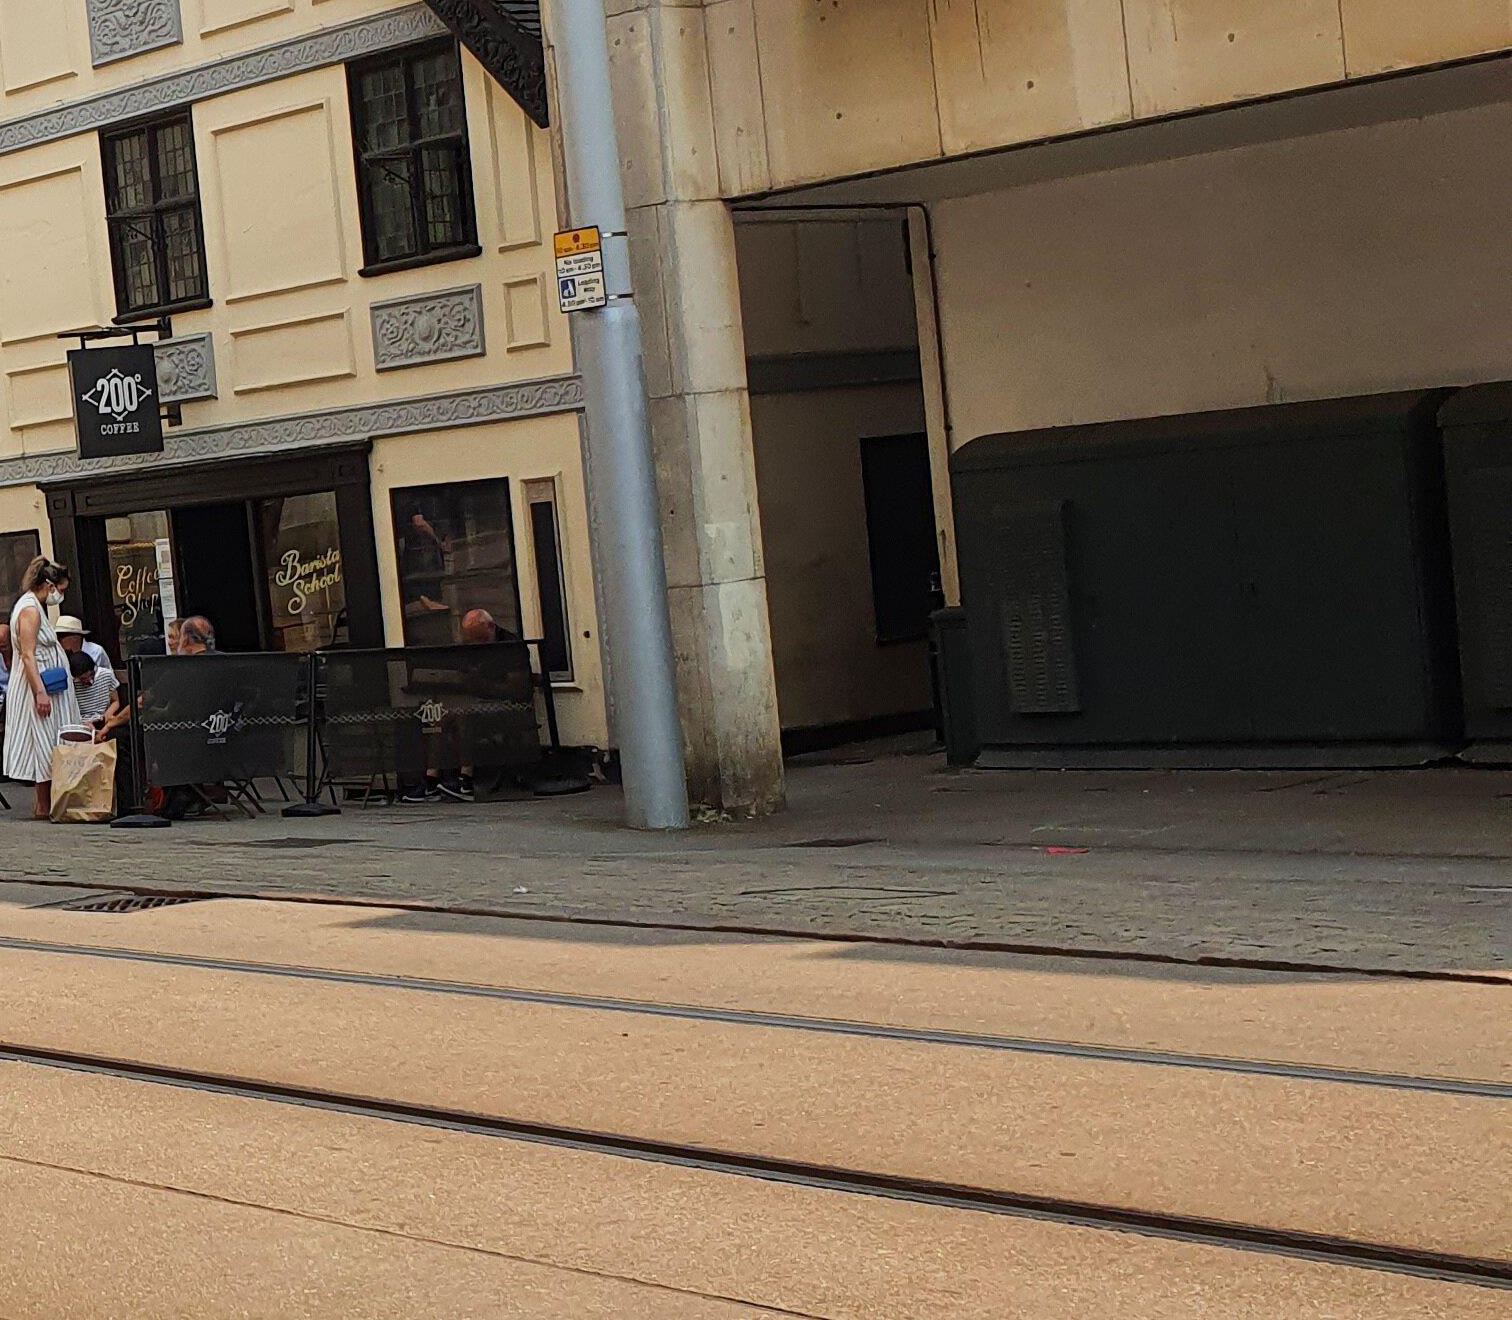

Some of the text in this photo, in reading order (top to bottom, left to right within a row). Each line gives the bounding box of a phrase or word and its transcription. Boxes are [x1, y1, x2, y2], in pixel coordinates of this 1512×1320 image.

[100, 422, 140, 435] COFFEE
[276, 547, 340, 587] Barista
[288, 563, 341, 614] School
